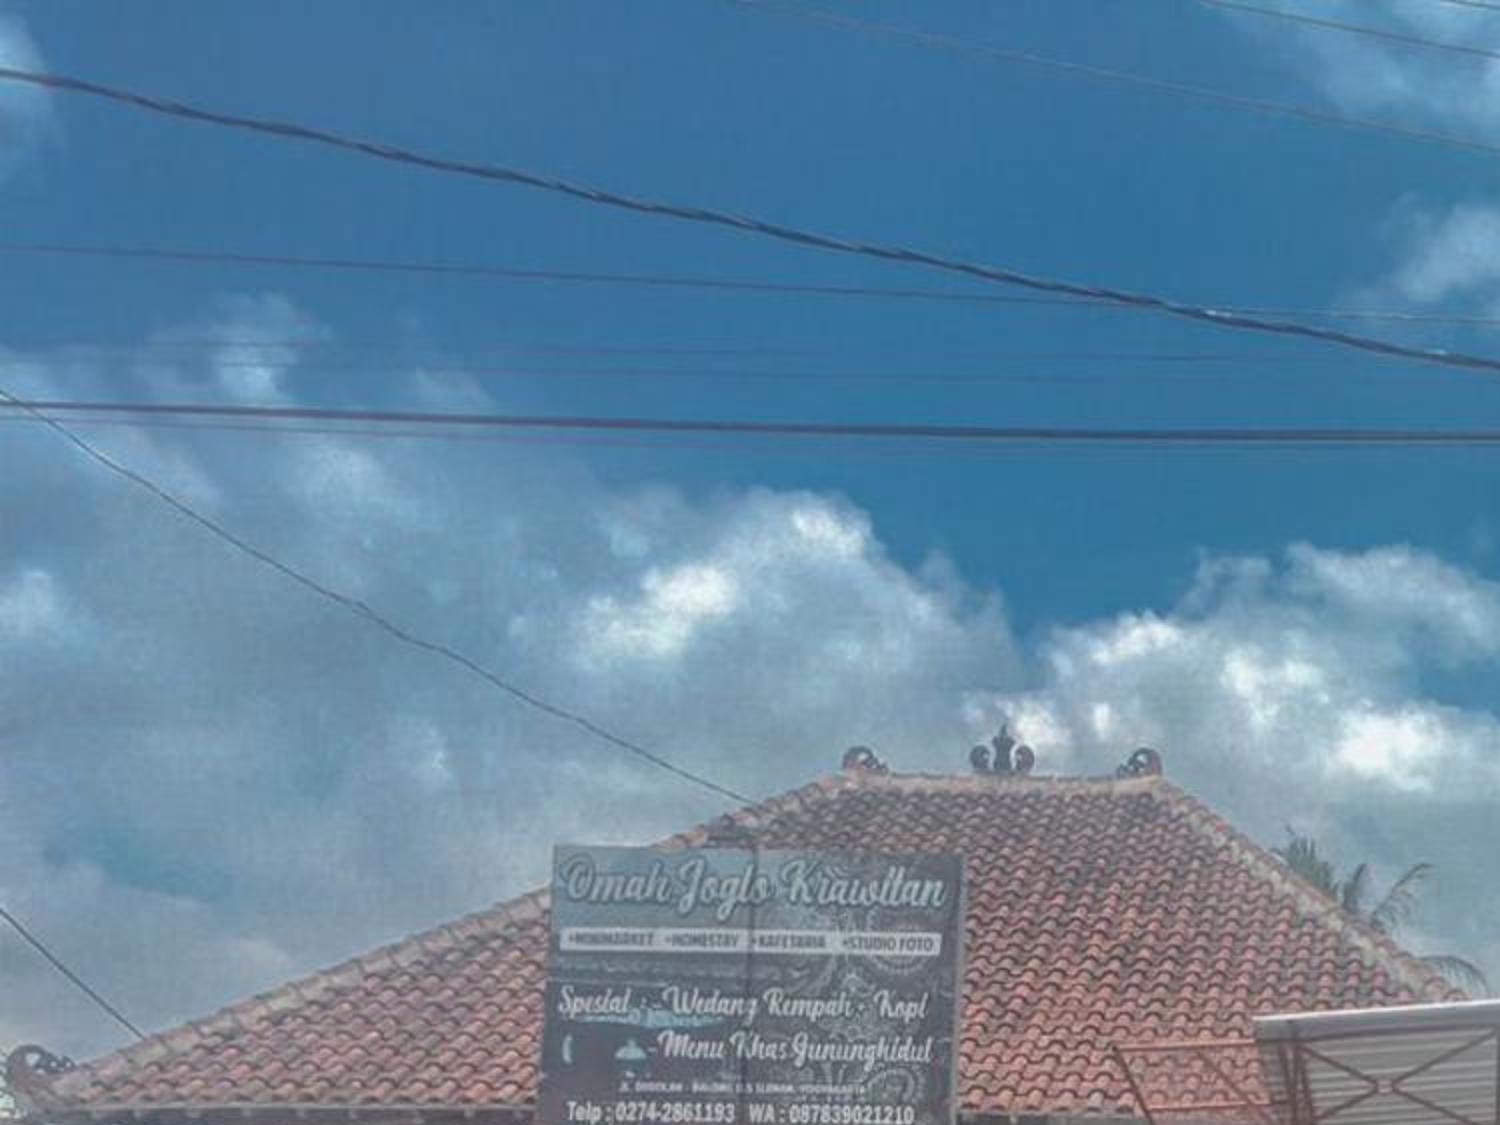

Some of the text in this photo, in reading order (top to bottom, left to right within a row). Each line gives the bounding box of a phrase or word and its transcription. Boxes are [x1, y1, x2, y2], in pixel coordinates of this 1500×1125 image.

[560, 856, 672, 901] Omah
[677, 858, 771, 921] Joglo
[662, 985, 758, 1025] Wedang
[763, 987, 851, 1022] Rempah
[657, 1029, 725, 1060] Menu
[729, 1030, 787, 1060] Khas
[566, 1101, 602, 1122] Telp
[749, 1103, 776, 1123] WA
